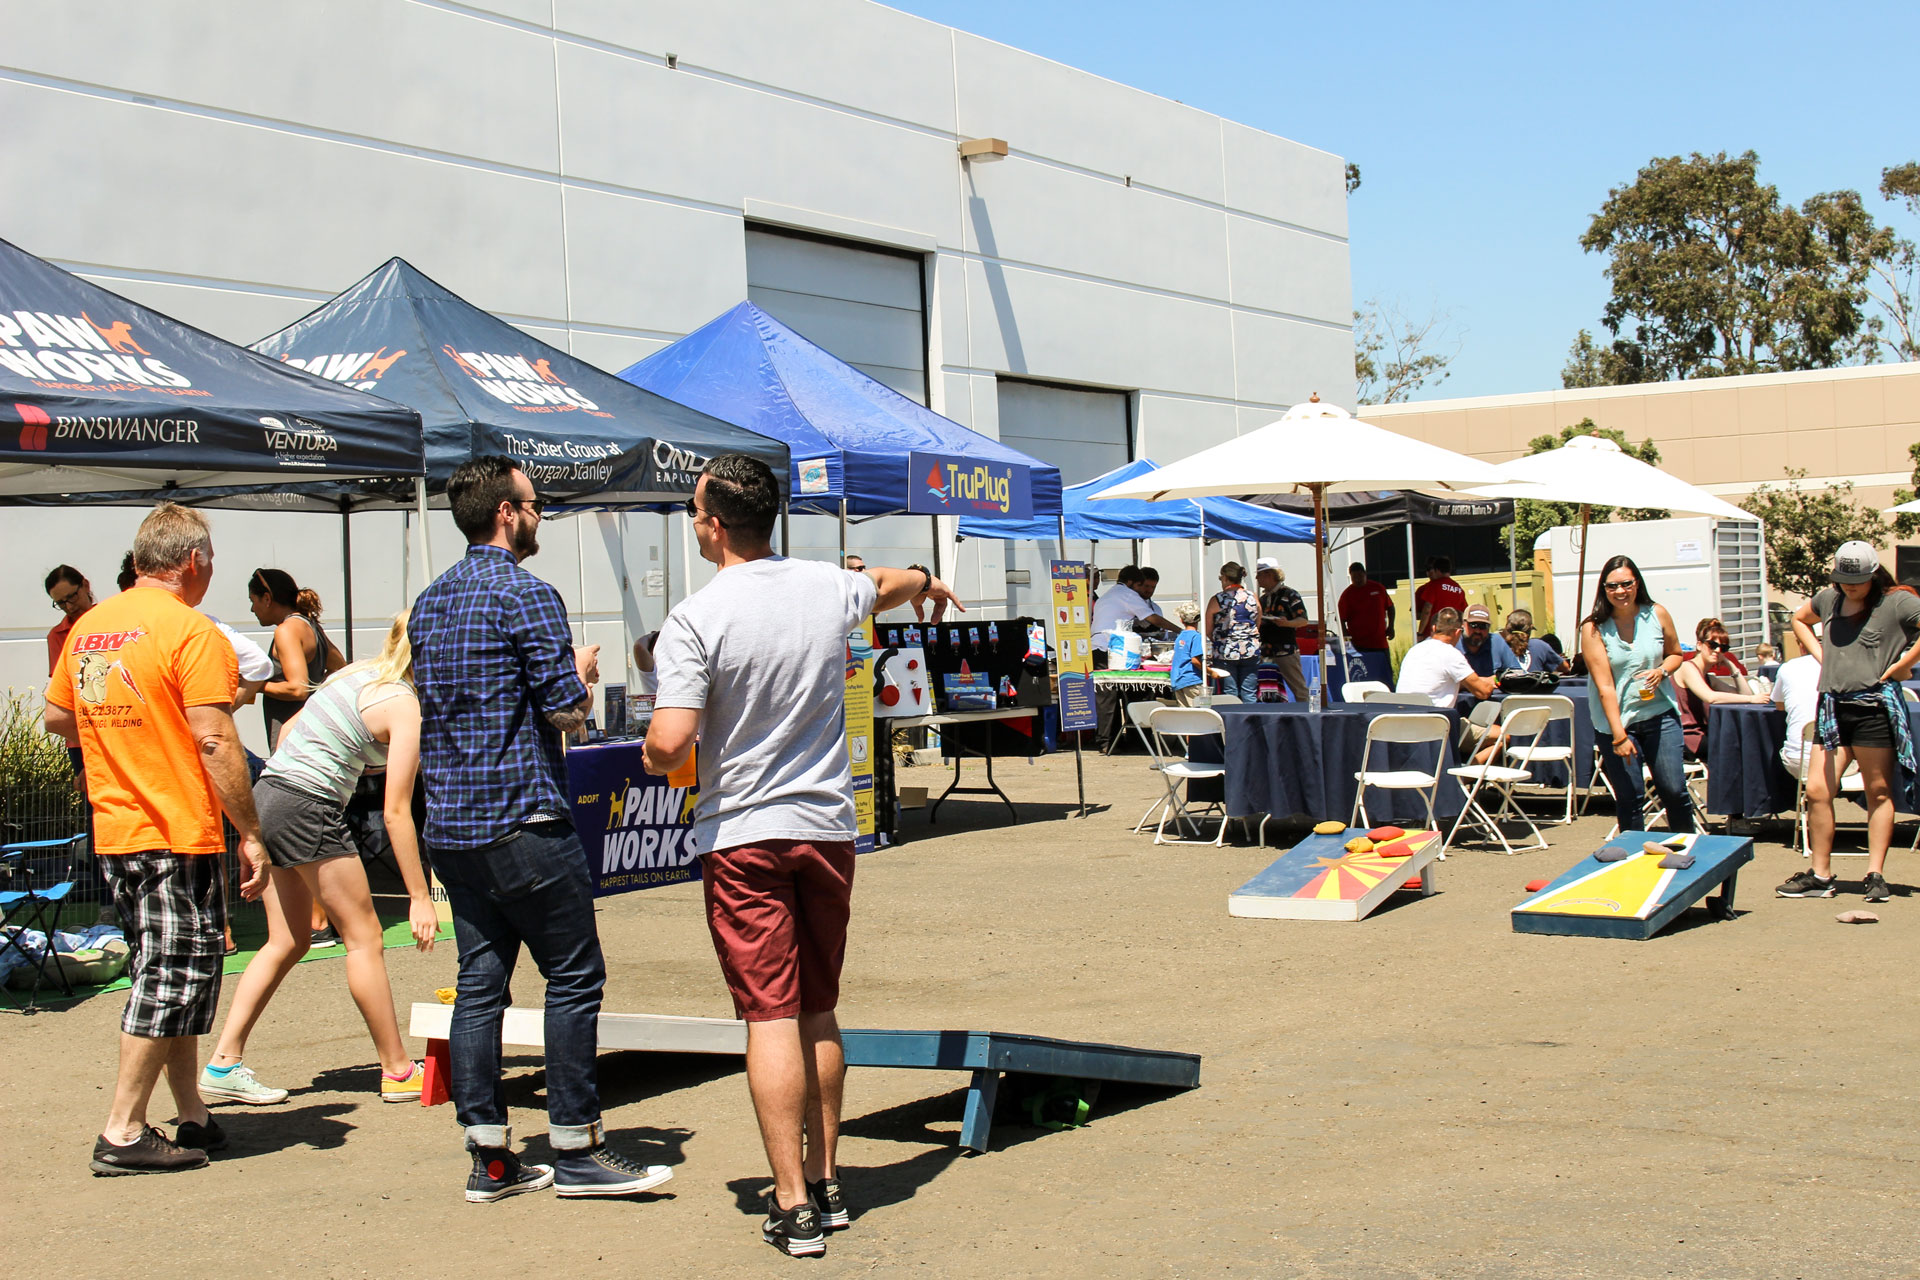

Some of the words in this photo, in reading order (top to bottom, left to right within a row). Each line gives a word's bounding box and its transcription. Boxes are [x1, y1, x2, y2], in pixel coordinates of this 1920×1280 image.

[0, 311, 111, 351] PAW
[0, 349, 192, 388] WORKS
[459, 352, 545, 383] PAW
[471, 377, 599, 411] WORKS
[55, 416, 200, 444] BINSWANGER
[264, 430, 338, 452] VENTURA
[503, 434, 530, 456] The
[528, 438, 565, 458] Soter
[564, 441, 608, 460] Group
[606, 442, 624, 456] at
[520, 460, 570, 484] Morgan
[570, 460, 613, 485] Stanley
[656, 471, 699, 484] EMPLOY
[1442, 584, 1463, 594] STAFF
[72, 632, 129, 655] LBW
[111, 718, 143, 728] WELDING
[577, 793, 600, 805] ADOPT
[622, 786, 687, 827] PAW
[602, 828, 698, 875] WORKS
[600, 875, 629, 889] HAPPIEST
[630, 872, 648, 885] TAILS
[649, 871, 664, 882] ON
[665, 869, 691, 881] EARTH
